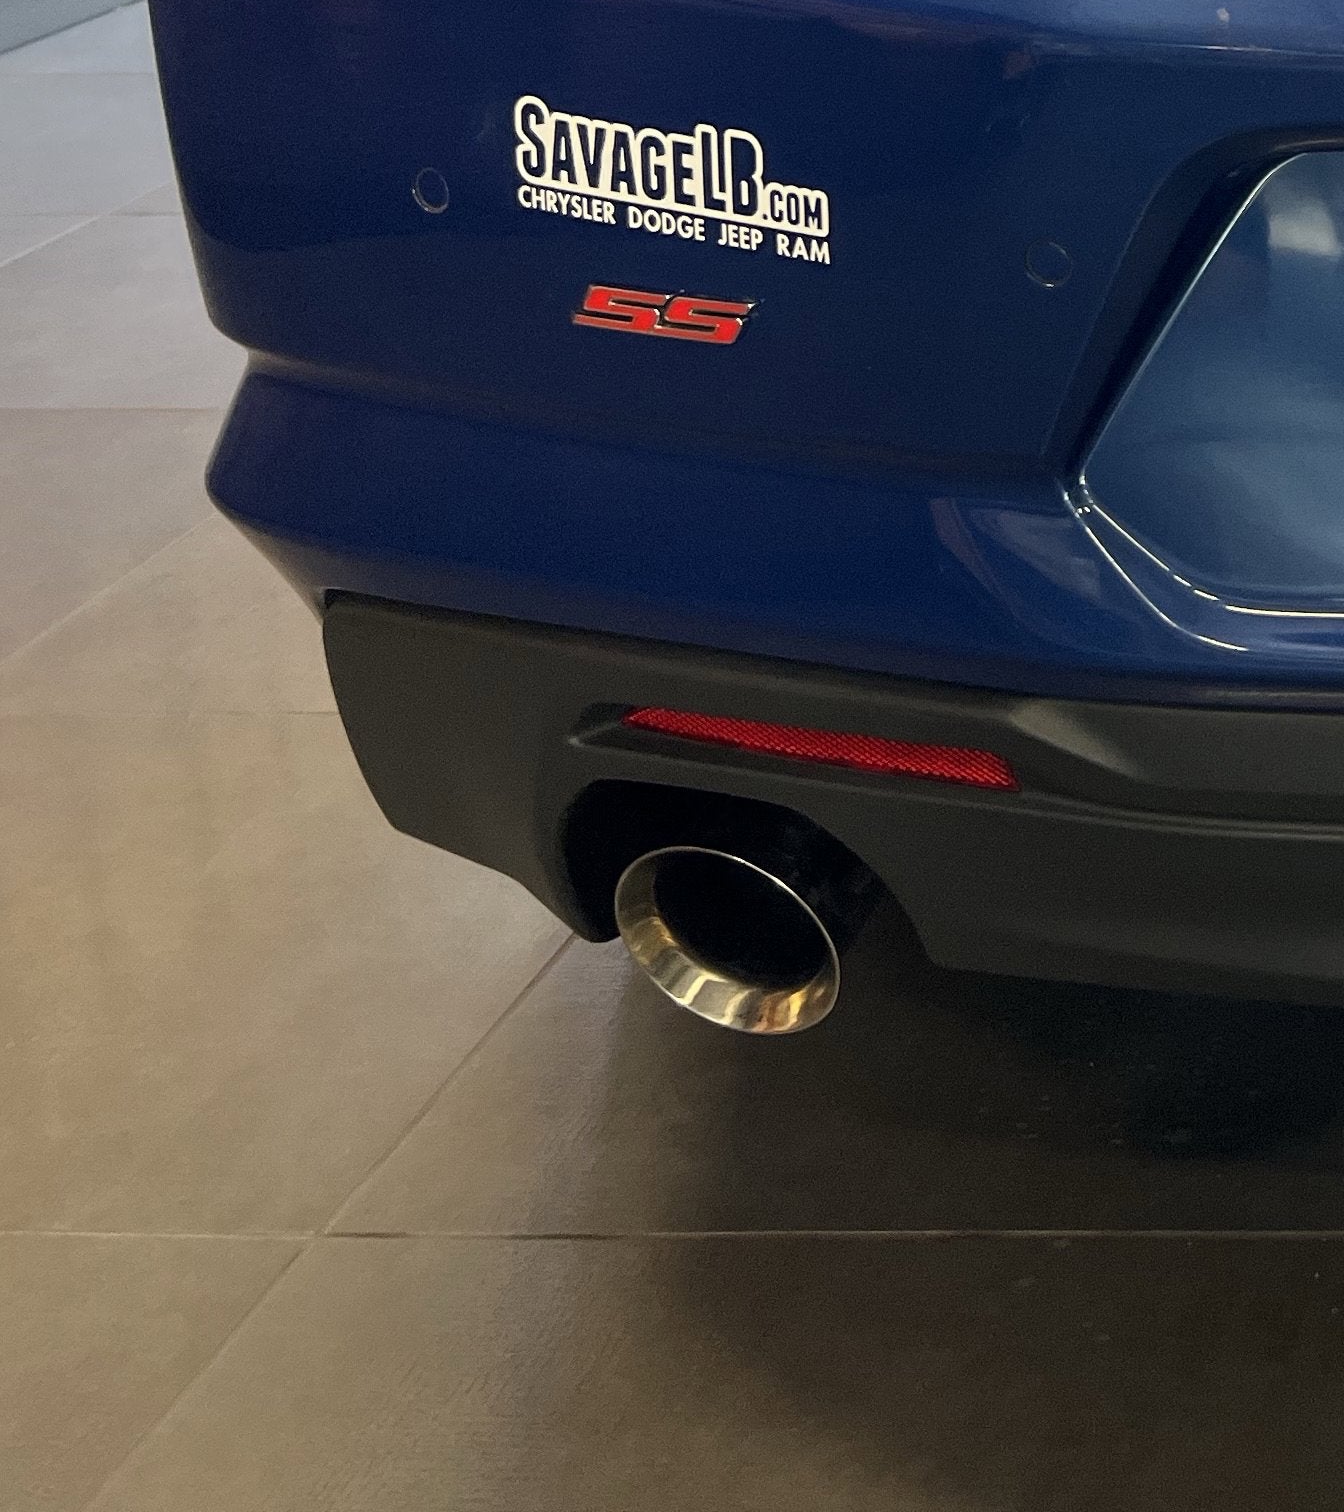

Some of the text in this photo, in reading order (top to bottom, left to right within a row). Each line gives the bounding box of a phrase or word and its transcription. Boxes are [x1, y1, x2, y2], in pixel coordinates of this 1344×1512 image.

[517, 184, 831, 265] CHRYSLER DODGE JEEP RAM
[572, 284, 755, 345] SS
